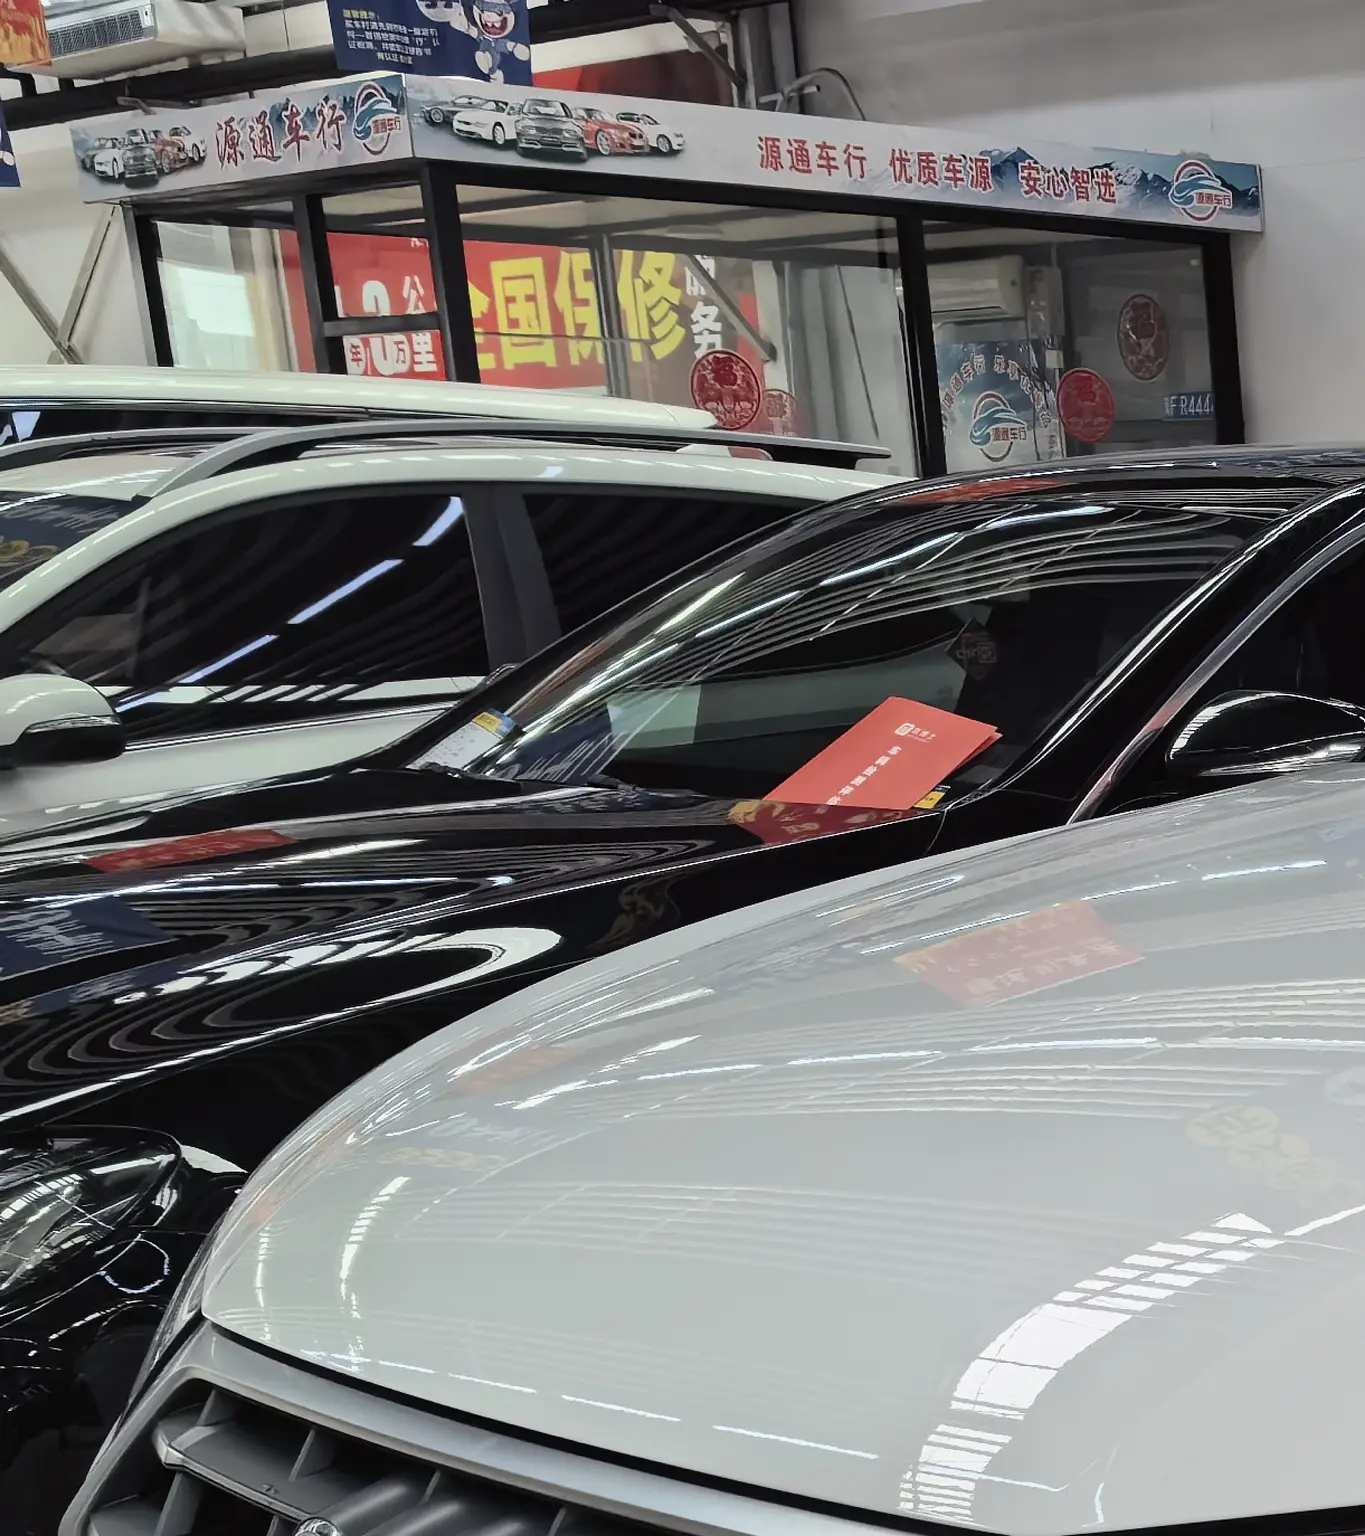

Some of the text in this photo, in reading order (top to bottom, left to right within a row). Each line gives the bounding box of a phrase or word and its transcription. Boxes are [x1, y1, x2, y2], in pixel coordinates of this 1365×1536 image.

[215, 103, 346, 168] 源通车行
[757, 135, 1118, 204] 源通车行 优质车源 安心智选
